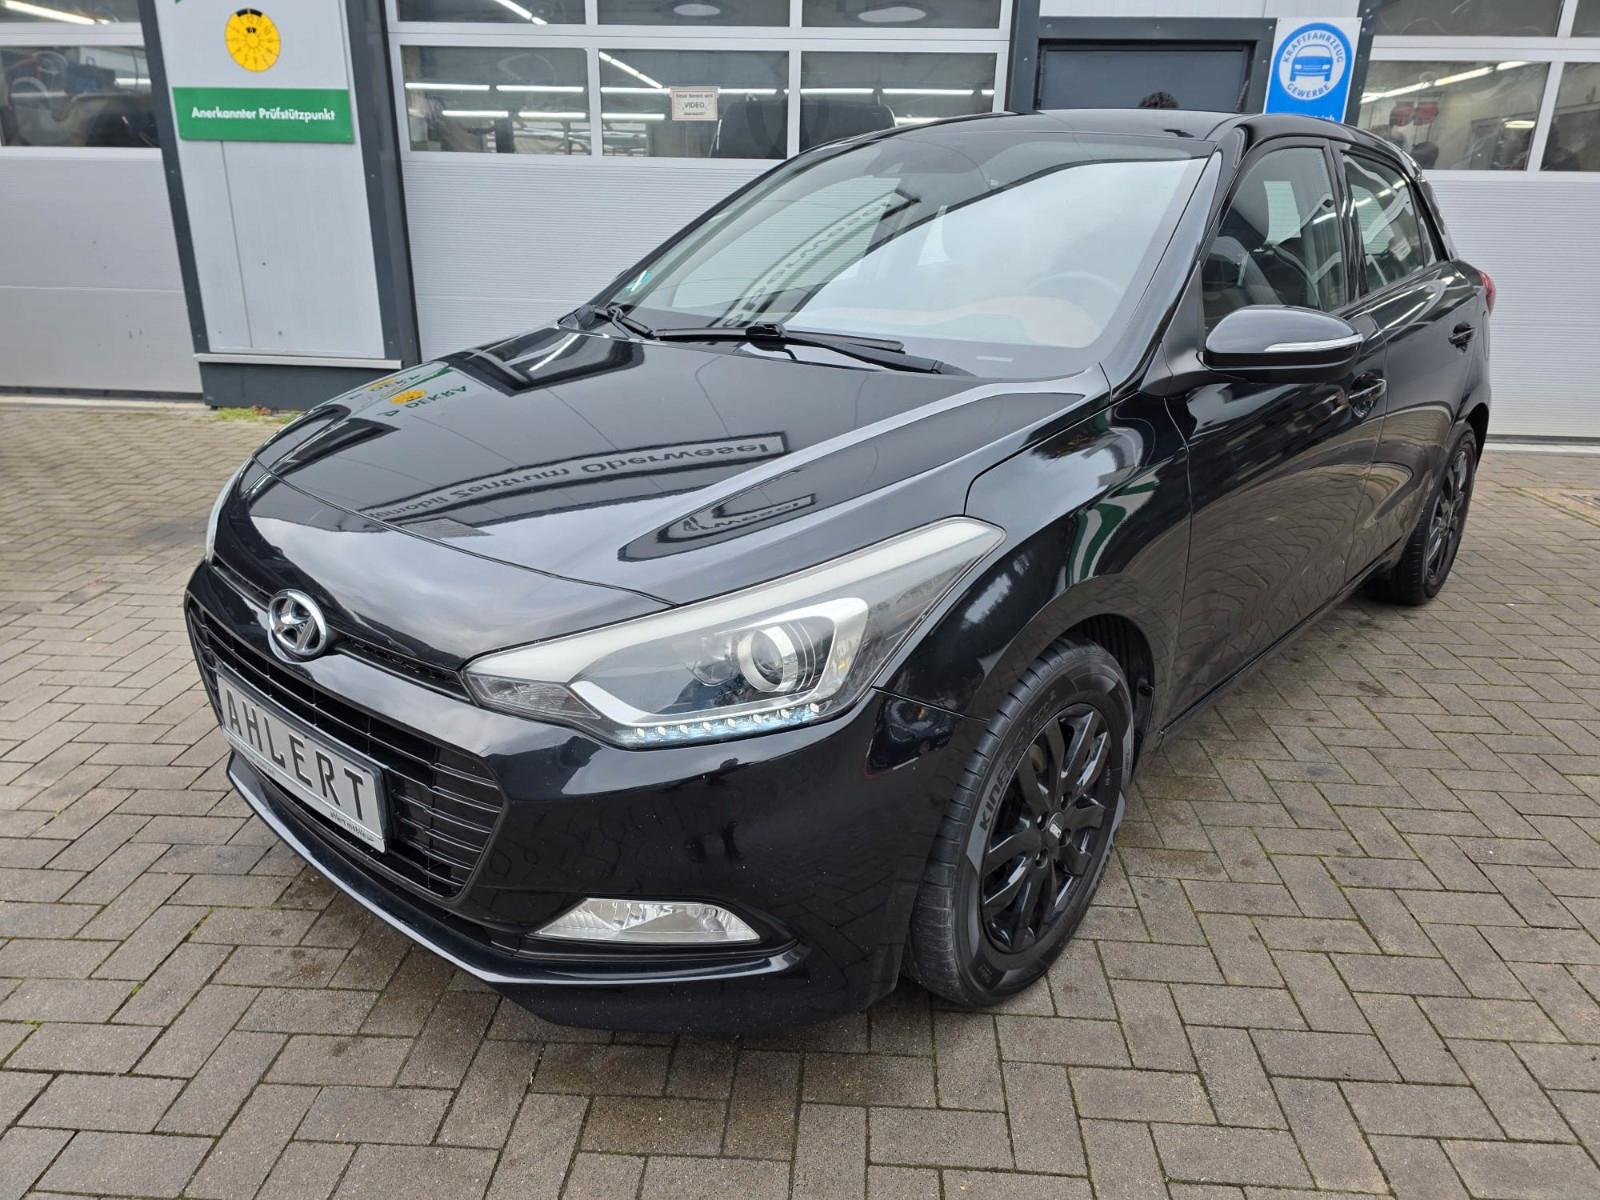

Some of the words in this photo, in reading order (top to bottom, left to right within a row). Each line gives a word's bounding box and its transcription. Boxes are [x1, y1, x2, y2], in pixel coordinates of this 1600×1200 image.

[1282, 32, 1345, 64] KRAFTFAHRZEUG
[1287, 82, 1331, 98] GEWERBE
[683, 101, 705, 109] VIDEO
[191, 106, 257, 120] Anerkannter
[258, 106, 336, 123] Prüfstützpunkt
[226, 688, 365, 821] AHLERT
